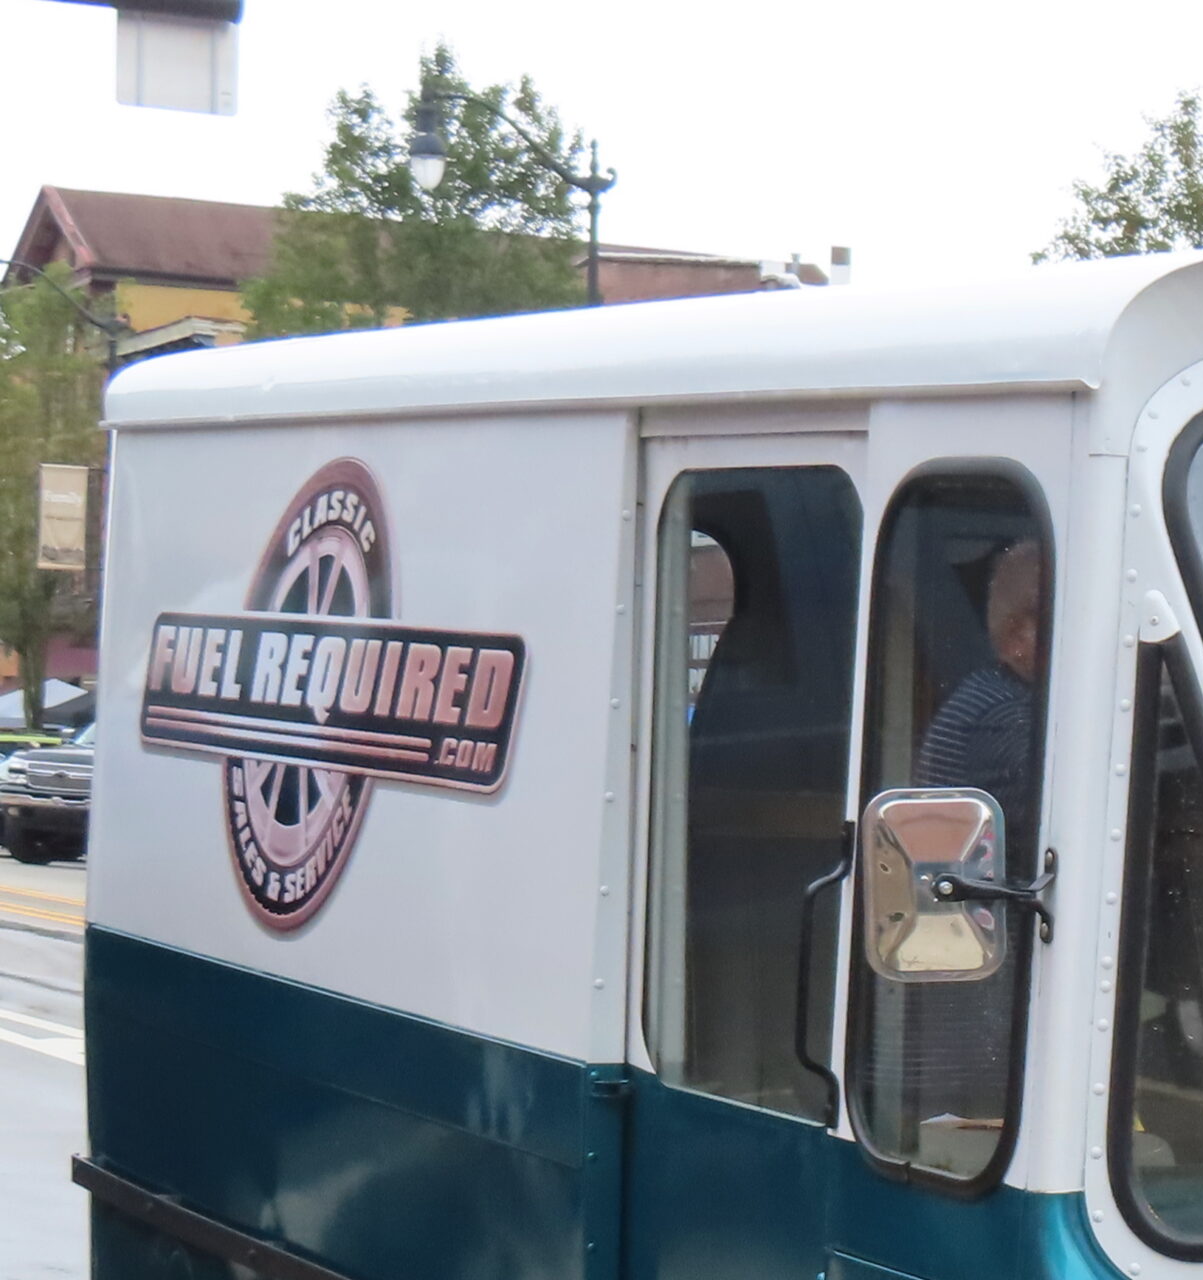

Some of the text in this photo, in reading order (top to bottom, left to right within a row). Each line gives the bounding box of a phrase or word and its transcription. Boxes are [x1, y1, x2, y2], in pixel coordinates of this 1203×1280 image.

[286, 490, 375, 557] CLASSIC
[149, 625, 515, 729] FUEL REQUIRED
[434, 738, 497, 772] .COM
[232, 766, 352, 903] SALES & SERVICE
